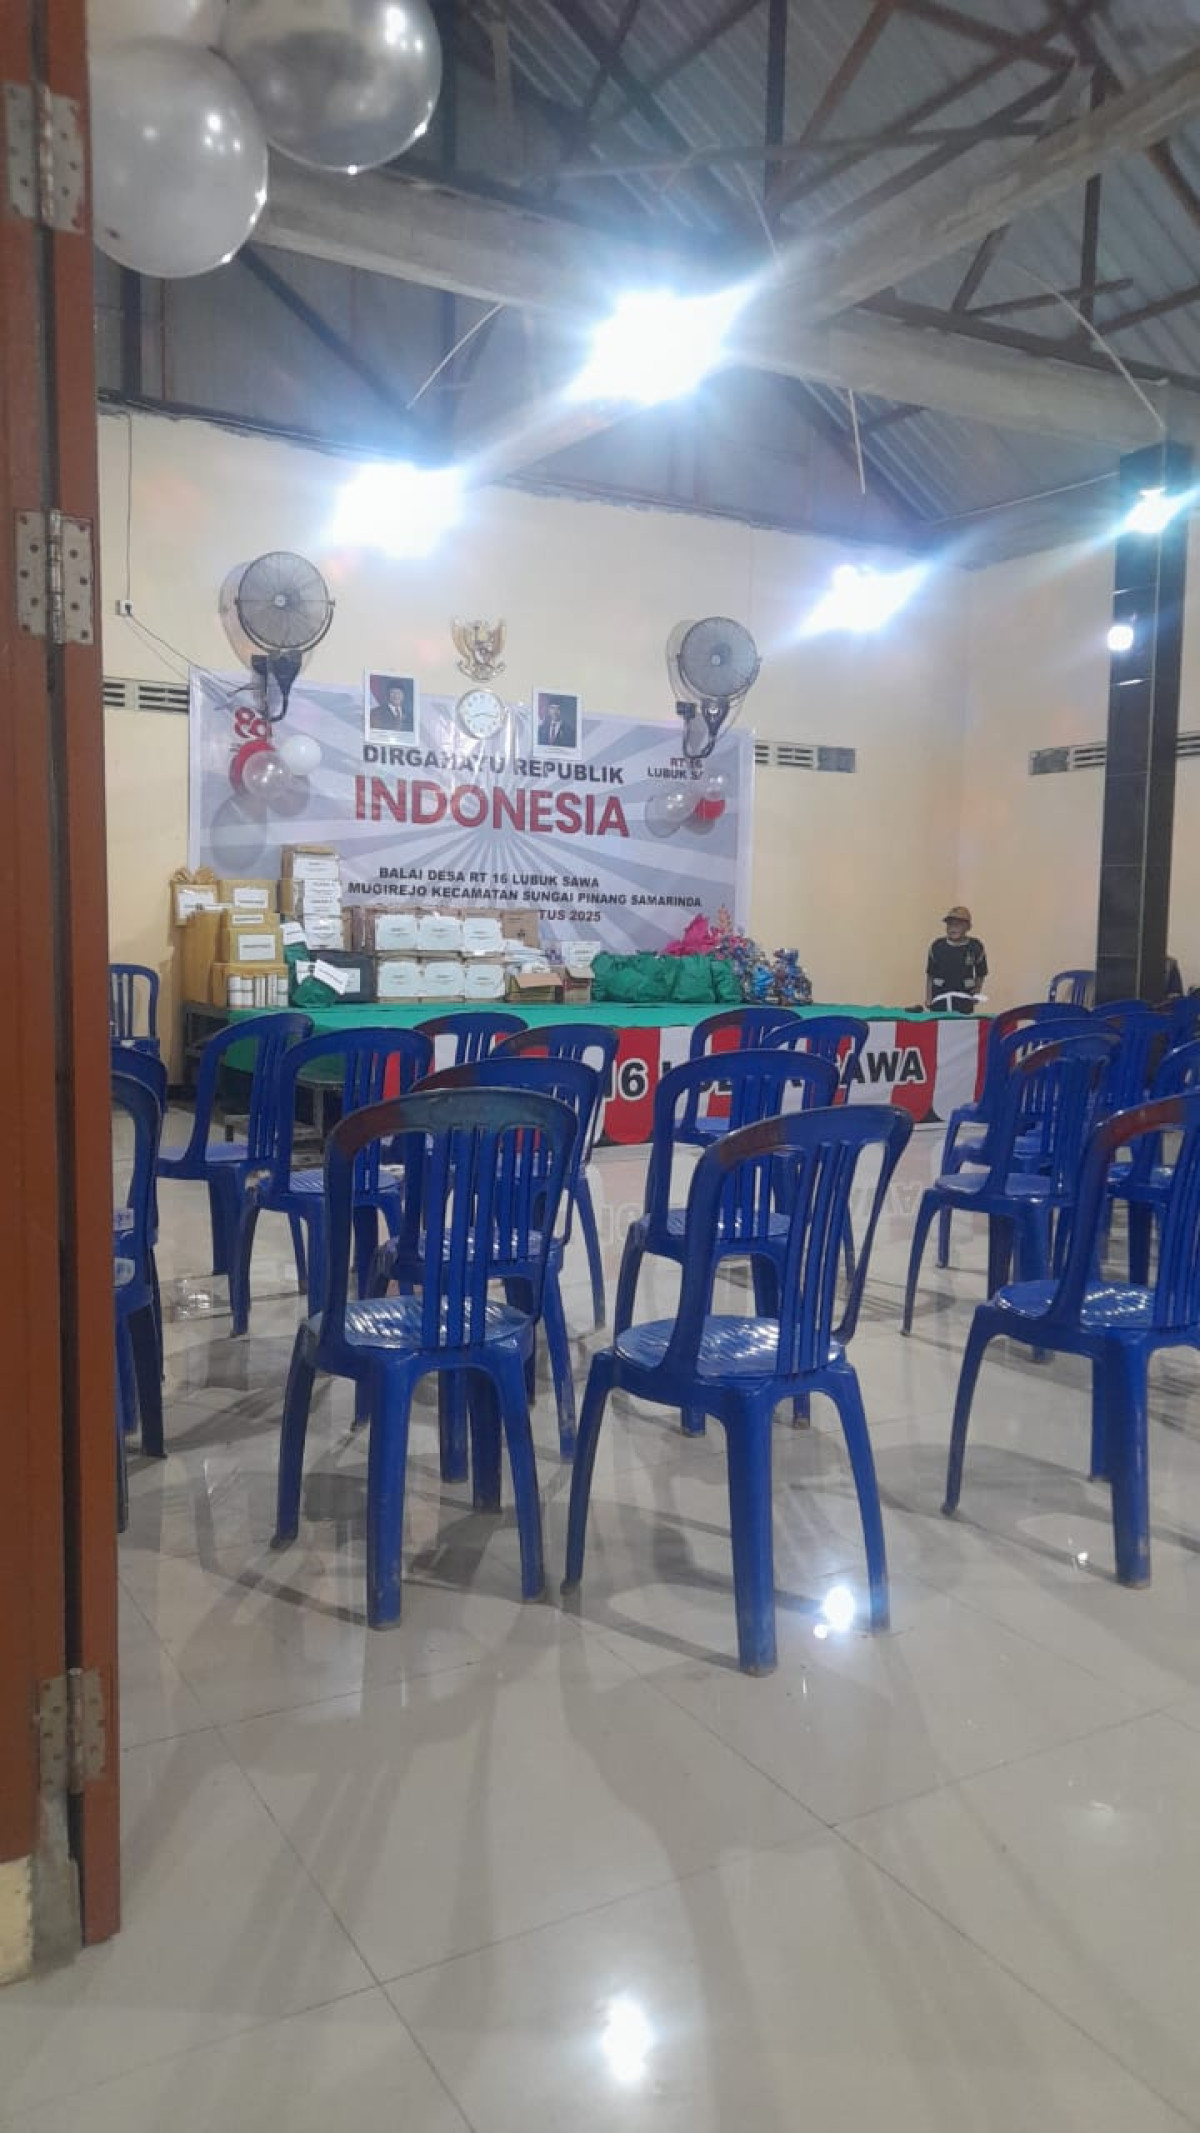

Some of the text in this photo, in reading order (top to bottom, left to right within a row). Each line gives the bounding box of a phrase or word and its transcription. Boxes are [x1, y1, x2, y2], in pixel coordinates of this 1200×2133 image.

[513, 757, 624, 784] REPUBLIK
[647, 765, 688, 779] LUBUK
[355, 774, 630, 838] INDONESIA
[379, 866, 600, 888] BALAI DESA RT 16 LUBUK SAWA
[348, 882, 427, 896] MUGIREJO
[431, 885, 518, 900] KECAMATAN
[522, 889, 574, 903] SUNGAI
[577, 892, 628, 905] PINANG
[631, 894, 701, 908] SAMARINDA
[538, 909, 601, 922] TUS 2025
[839, 1049, 926, 1085] AWA
